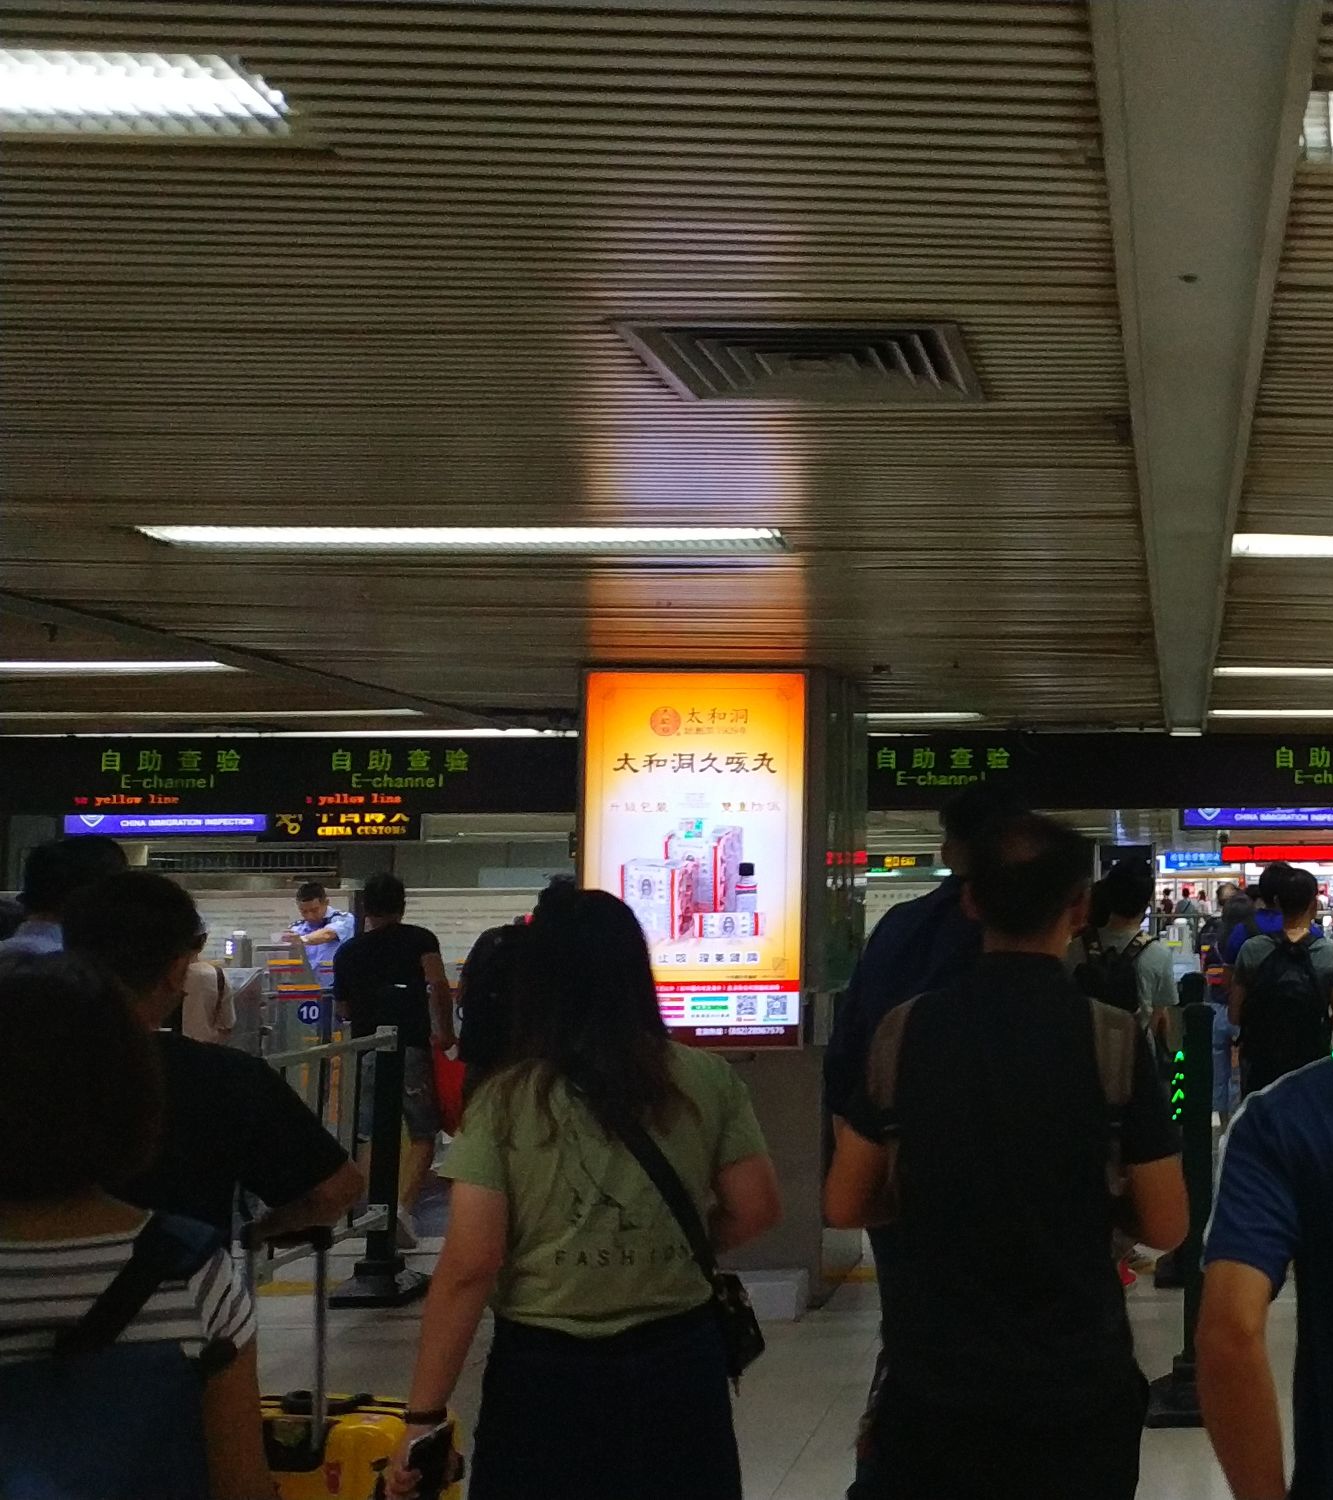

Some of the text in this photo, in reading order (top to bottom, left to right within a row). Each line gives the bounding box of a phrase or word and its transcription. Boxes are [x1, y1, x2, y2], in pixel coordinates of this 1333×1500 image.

[687, 707, 748, 724] 太和洞
[101, 749, 241, 772] 自助查验
[332, 748, 470, 772] 自助查验
[613, 752, 777, 773] 太和洞久咳丸
[877, 747, 1010, 769] 自助查验
[120, 774, 215, 788] E-channel
[351, 773, 444, 788] E-channel
[94, 794, 143, 807] yellow
[148, 794, 181, 804] line
[318, 793, 365, 806] yellow
[370, 793, 402, 804] line
[120, 819, 146, 827] CHINA
[317, 825, 407, 836] CHINA CUSTOMS
[300, 1005, 319, 1020] 10
